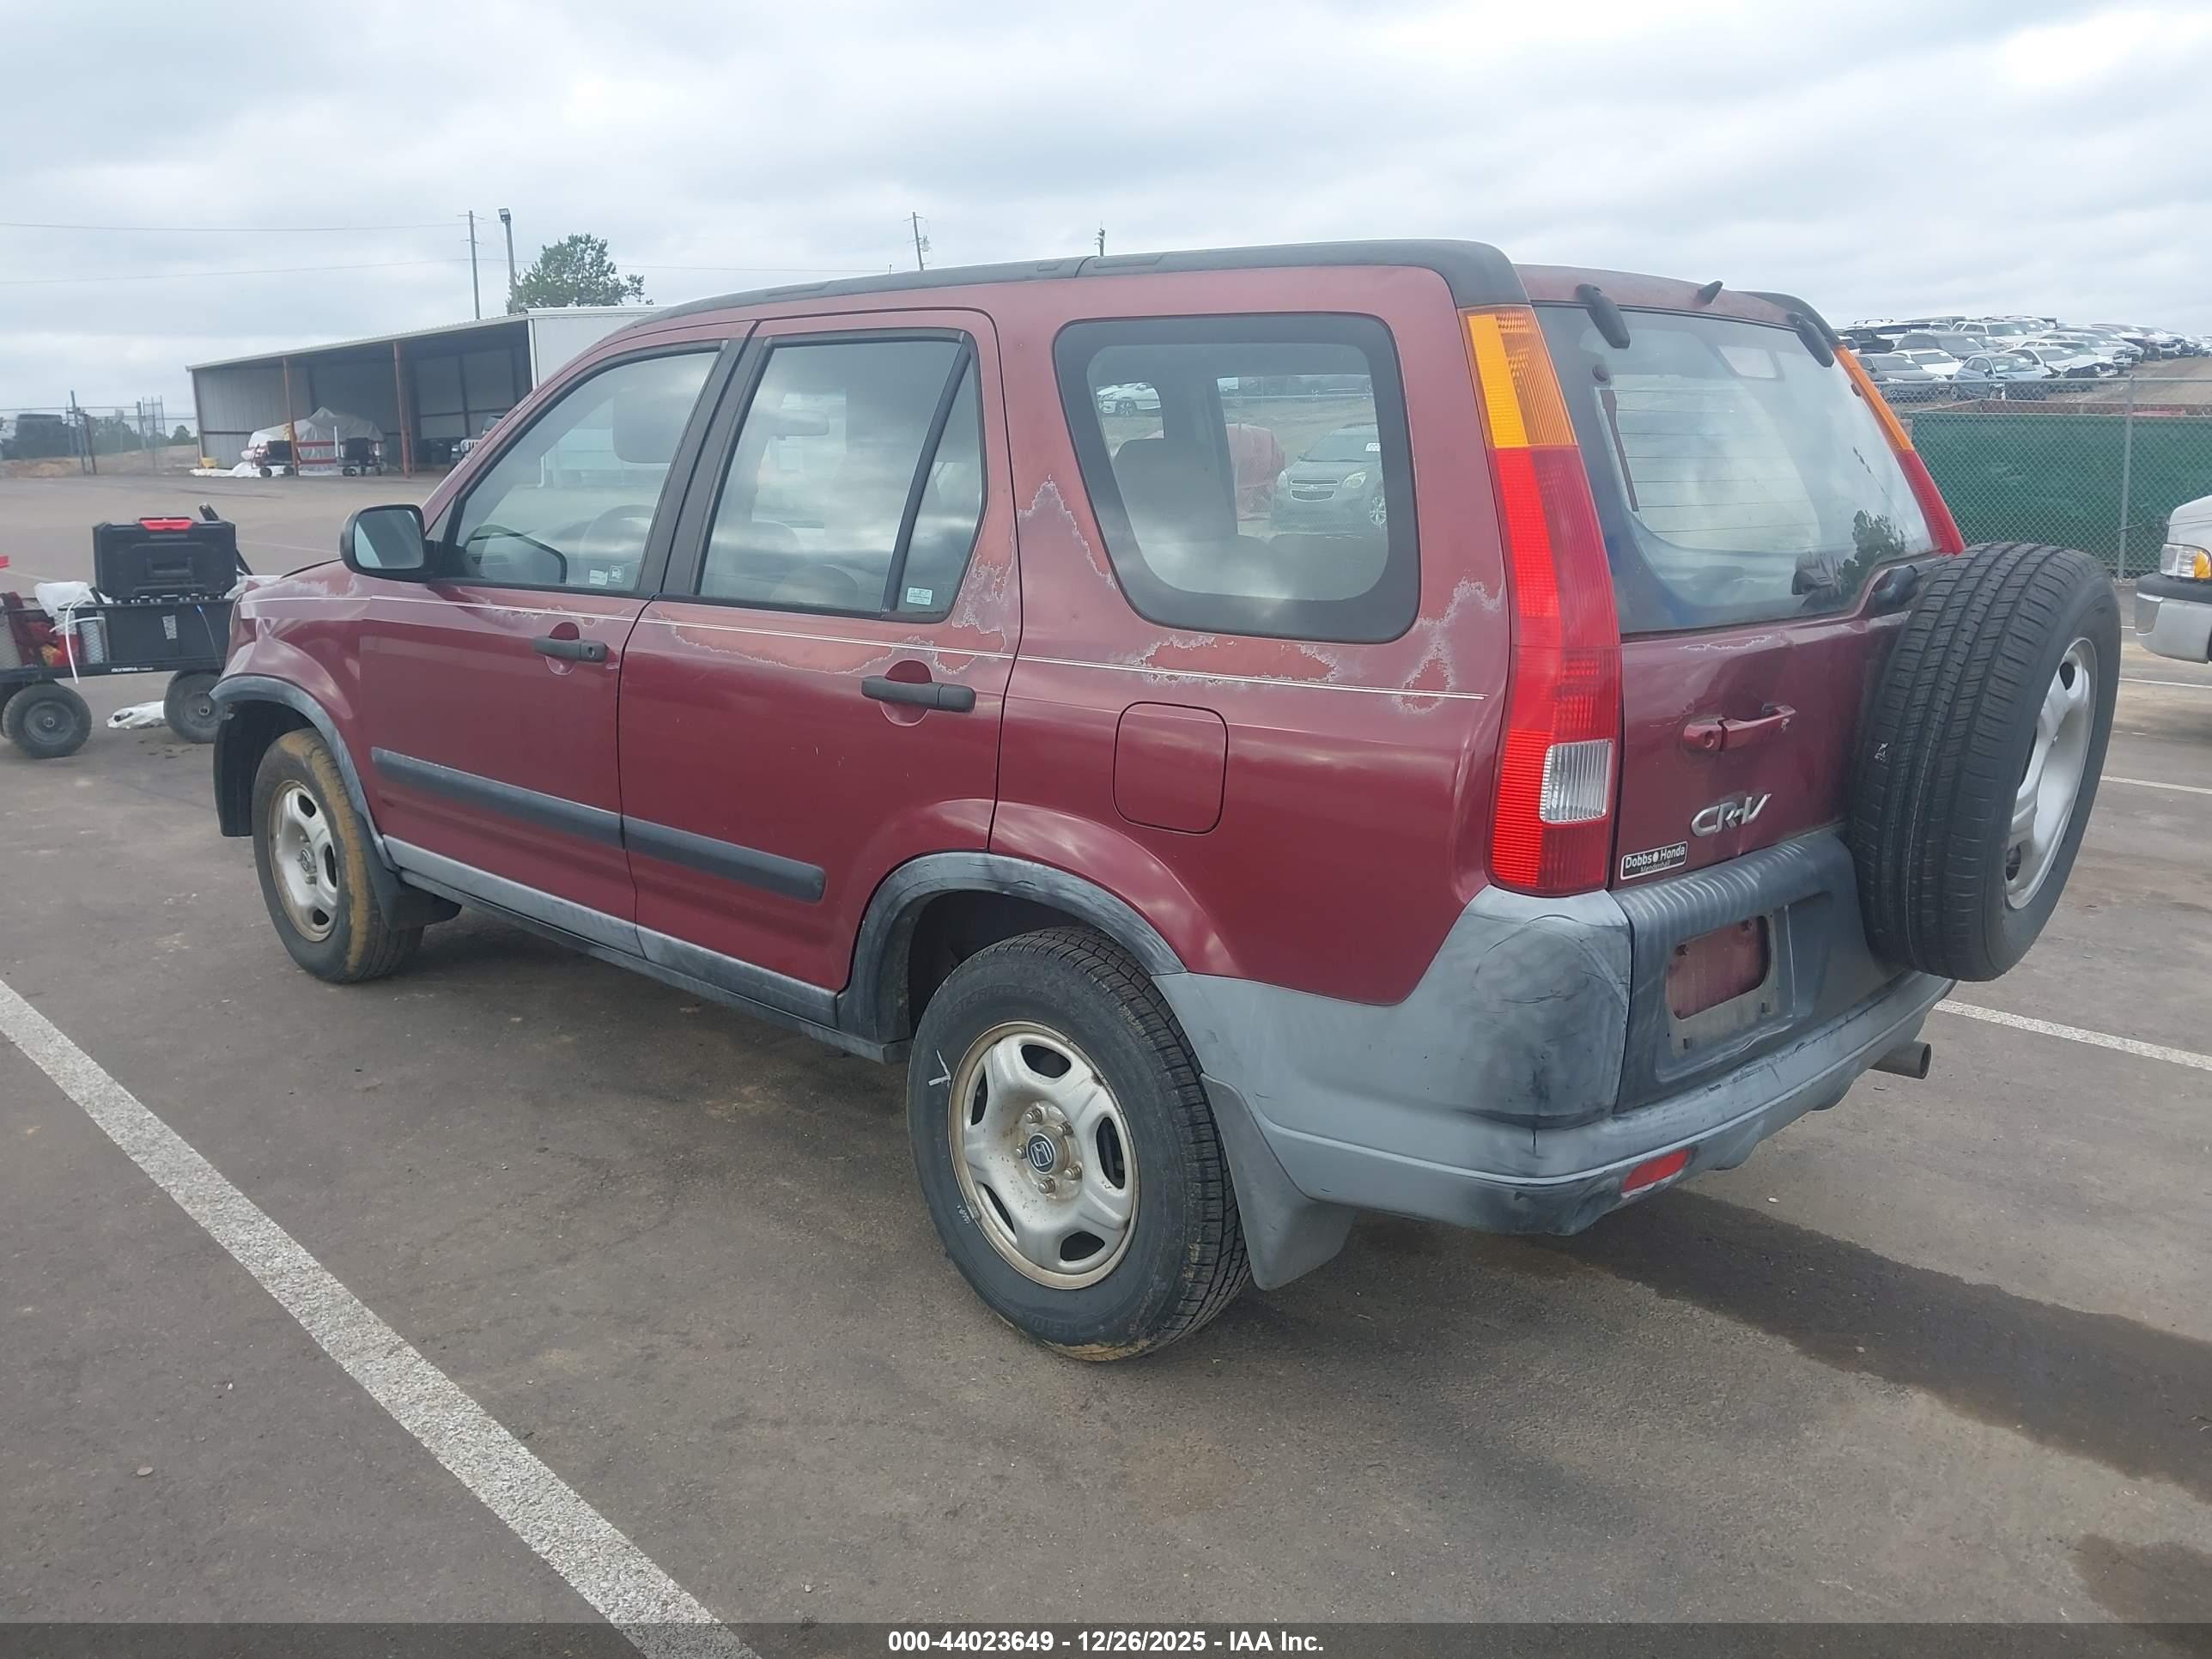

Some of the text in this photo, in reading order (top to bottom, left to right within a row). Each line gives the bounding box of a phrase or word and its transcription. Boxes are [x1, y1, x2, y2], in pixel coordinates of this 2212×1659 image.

[1691, 793, 1772, 837] CR-V
[1625, 845, 1686, 869] Dobbs Honda
